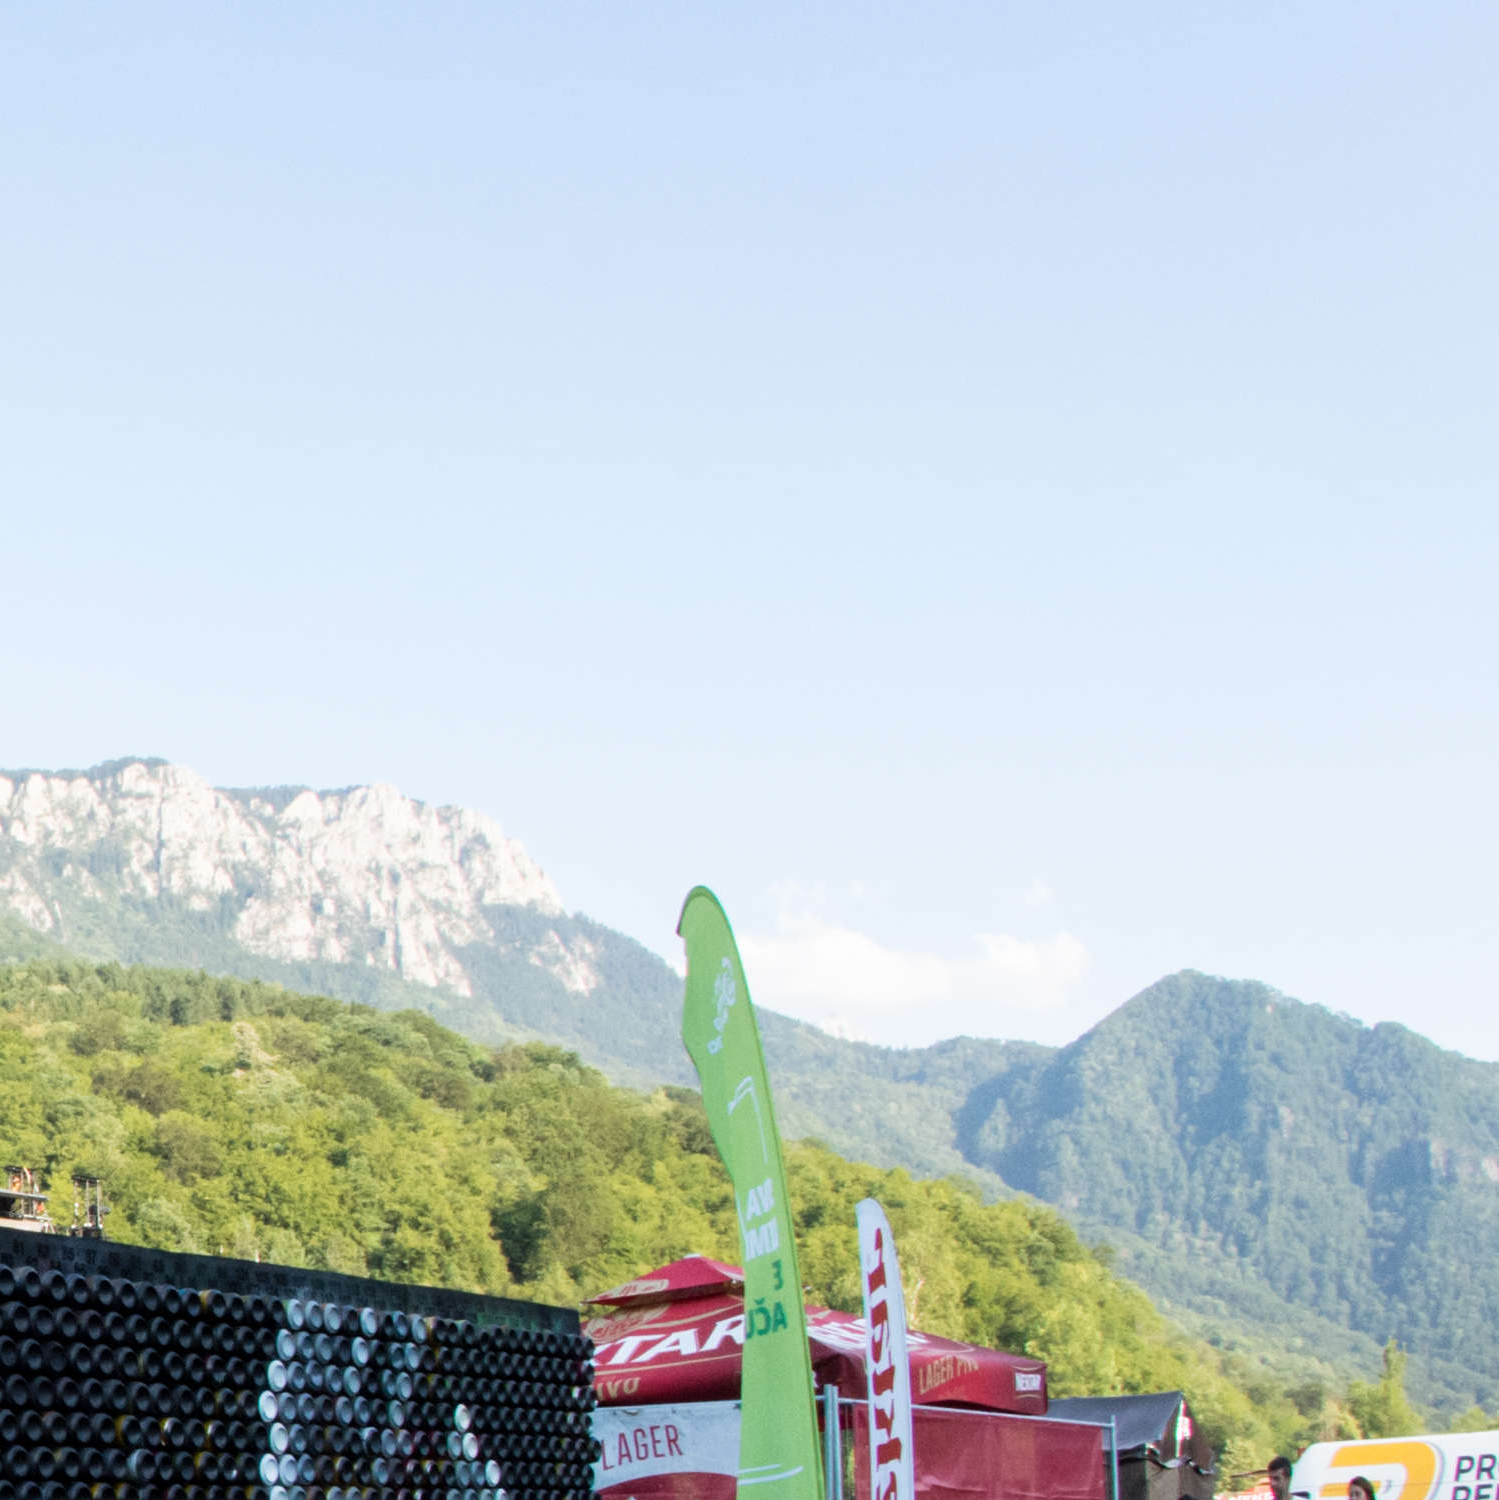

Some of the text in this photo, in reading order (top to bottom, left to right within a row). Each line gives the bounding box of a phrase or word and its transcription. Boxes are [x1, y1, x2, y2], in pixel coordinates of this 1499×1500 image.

[919, 1356, 954, 1395] LAGER
[601, 1424, 684, 1471] LAGER
[1454, 1454, 1499, 1482] PR
